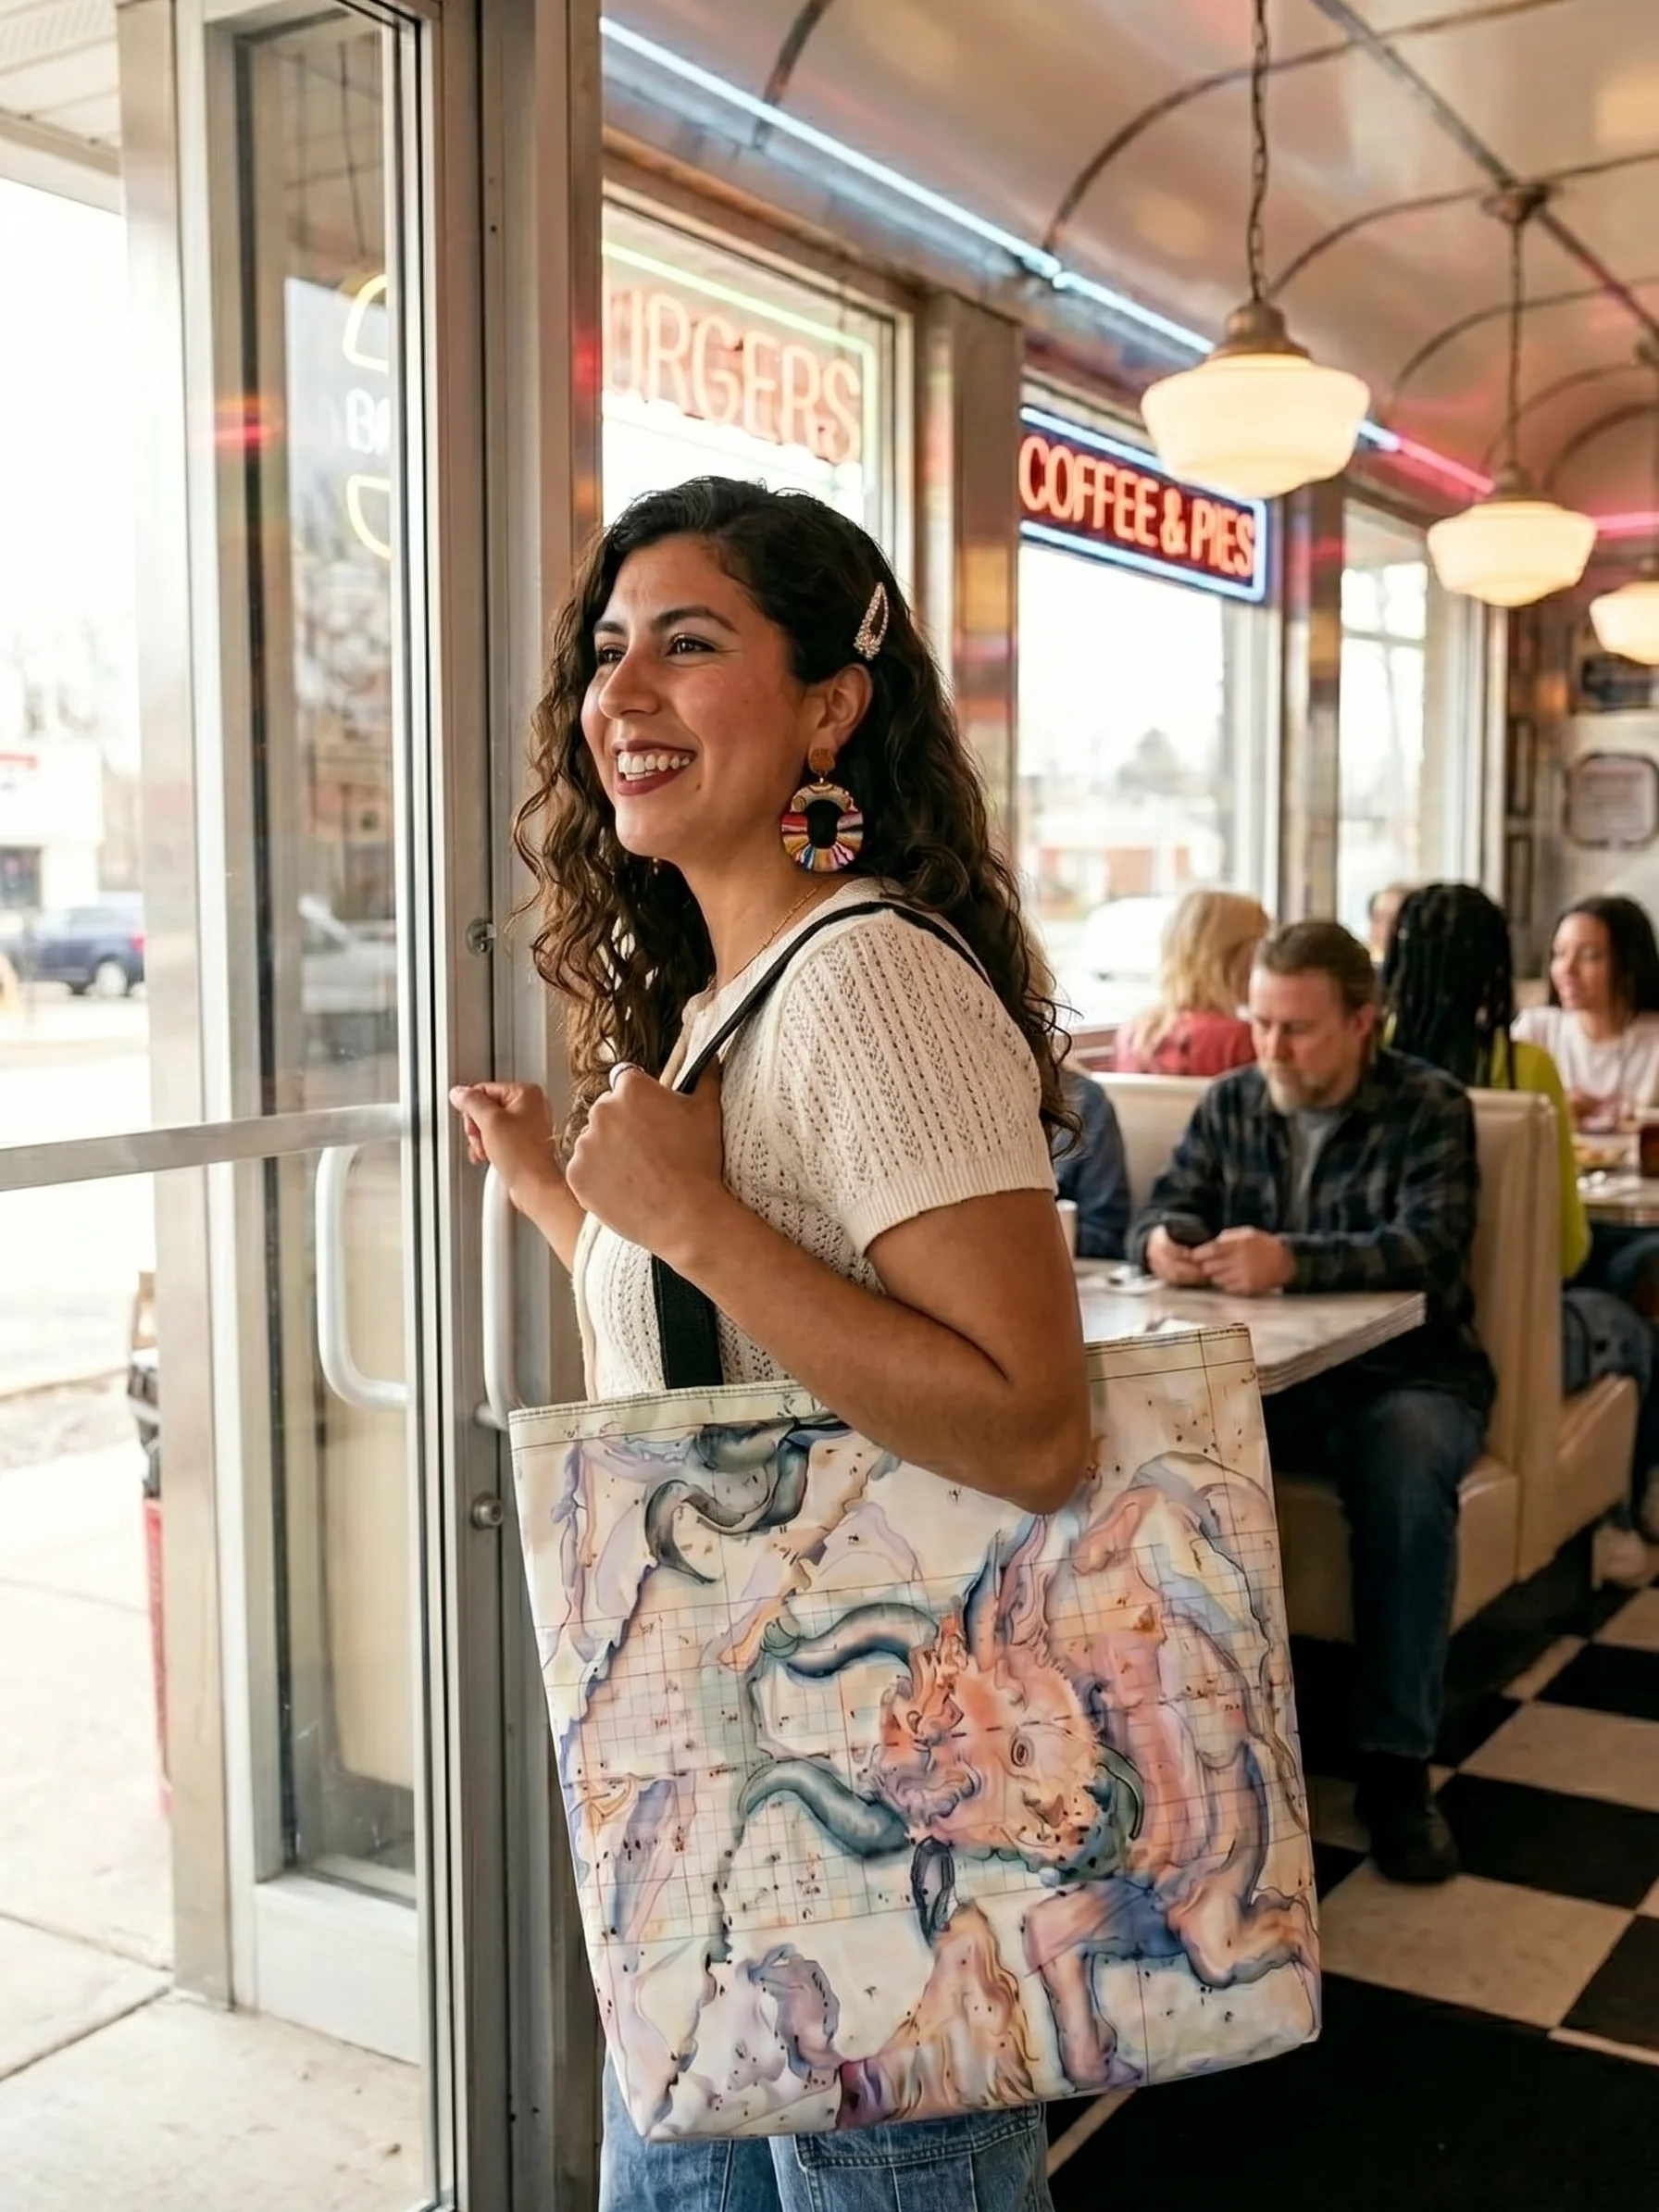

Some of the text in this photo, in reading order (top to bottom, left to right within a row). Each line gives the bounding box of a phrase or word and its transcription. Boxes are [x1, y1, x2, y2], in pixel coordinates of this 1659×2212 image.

[1018, 435, 1255, 578] COFFEE & PIES
